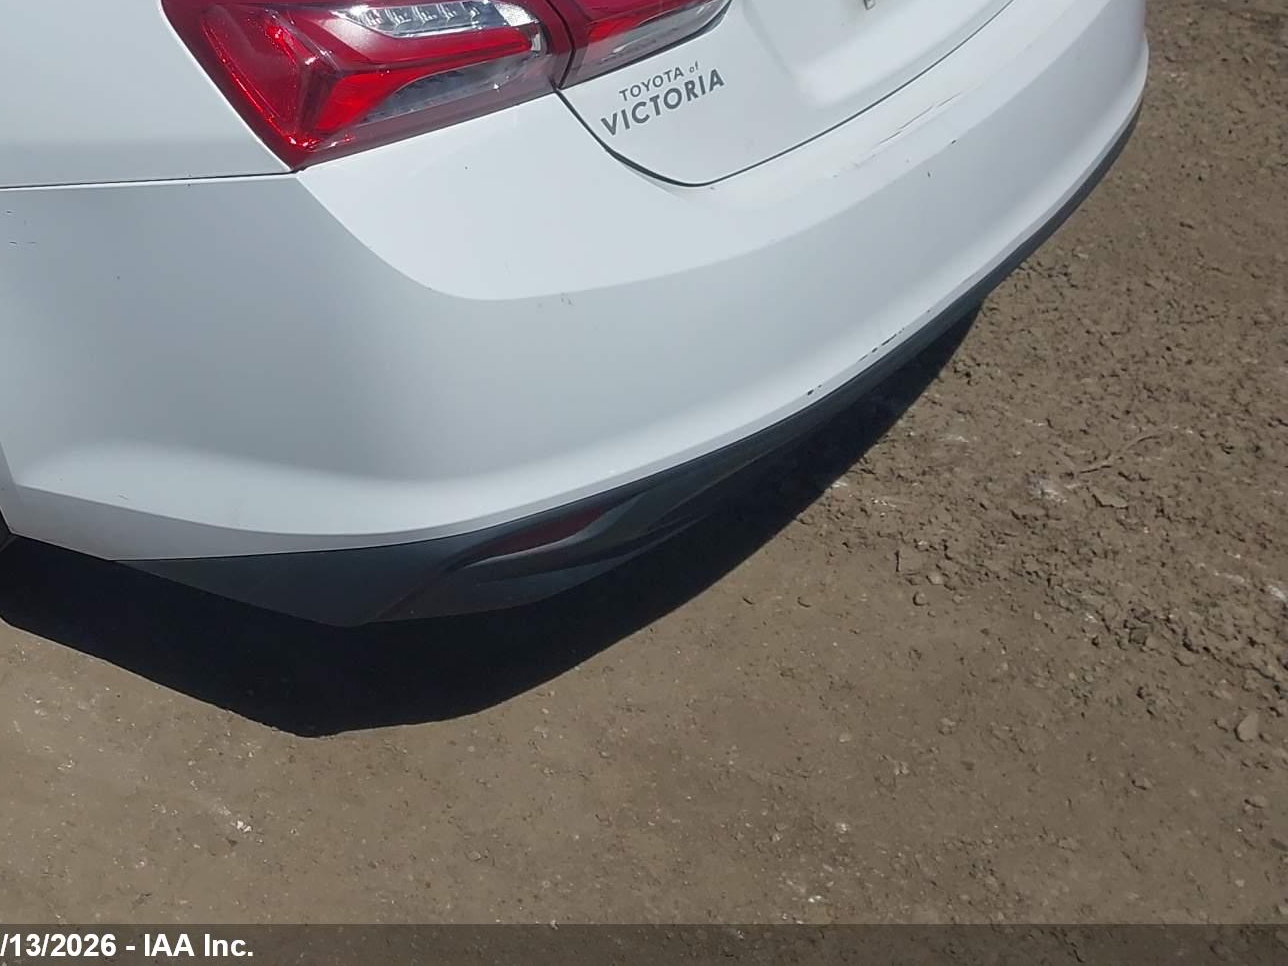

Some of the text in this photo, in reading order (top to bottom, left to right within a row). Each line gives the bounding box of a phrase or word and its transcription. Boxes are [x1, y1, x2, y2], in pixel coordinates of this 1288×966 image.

[600, 68, 725, 136] VICTORIA
[619, 61, 699, 102] TOYOTA of
